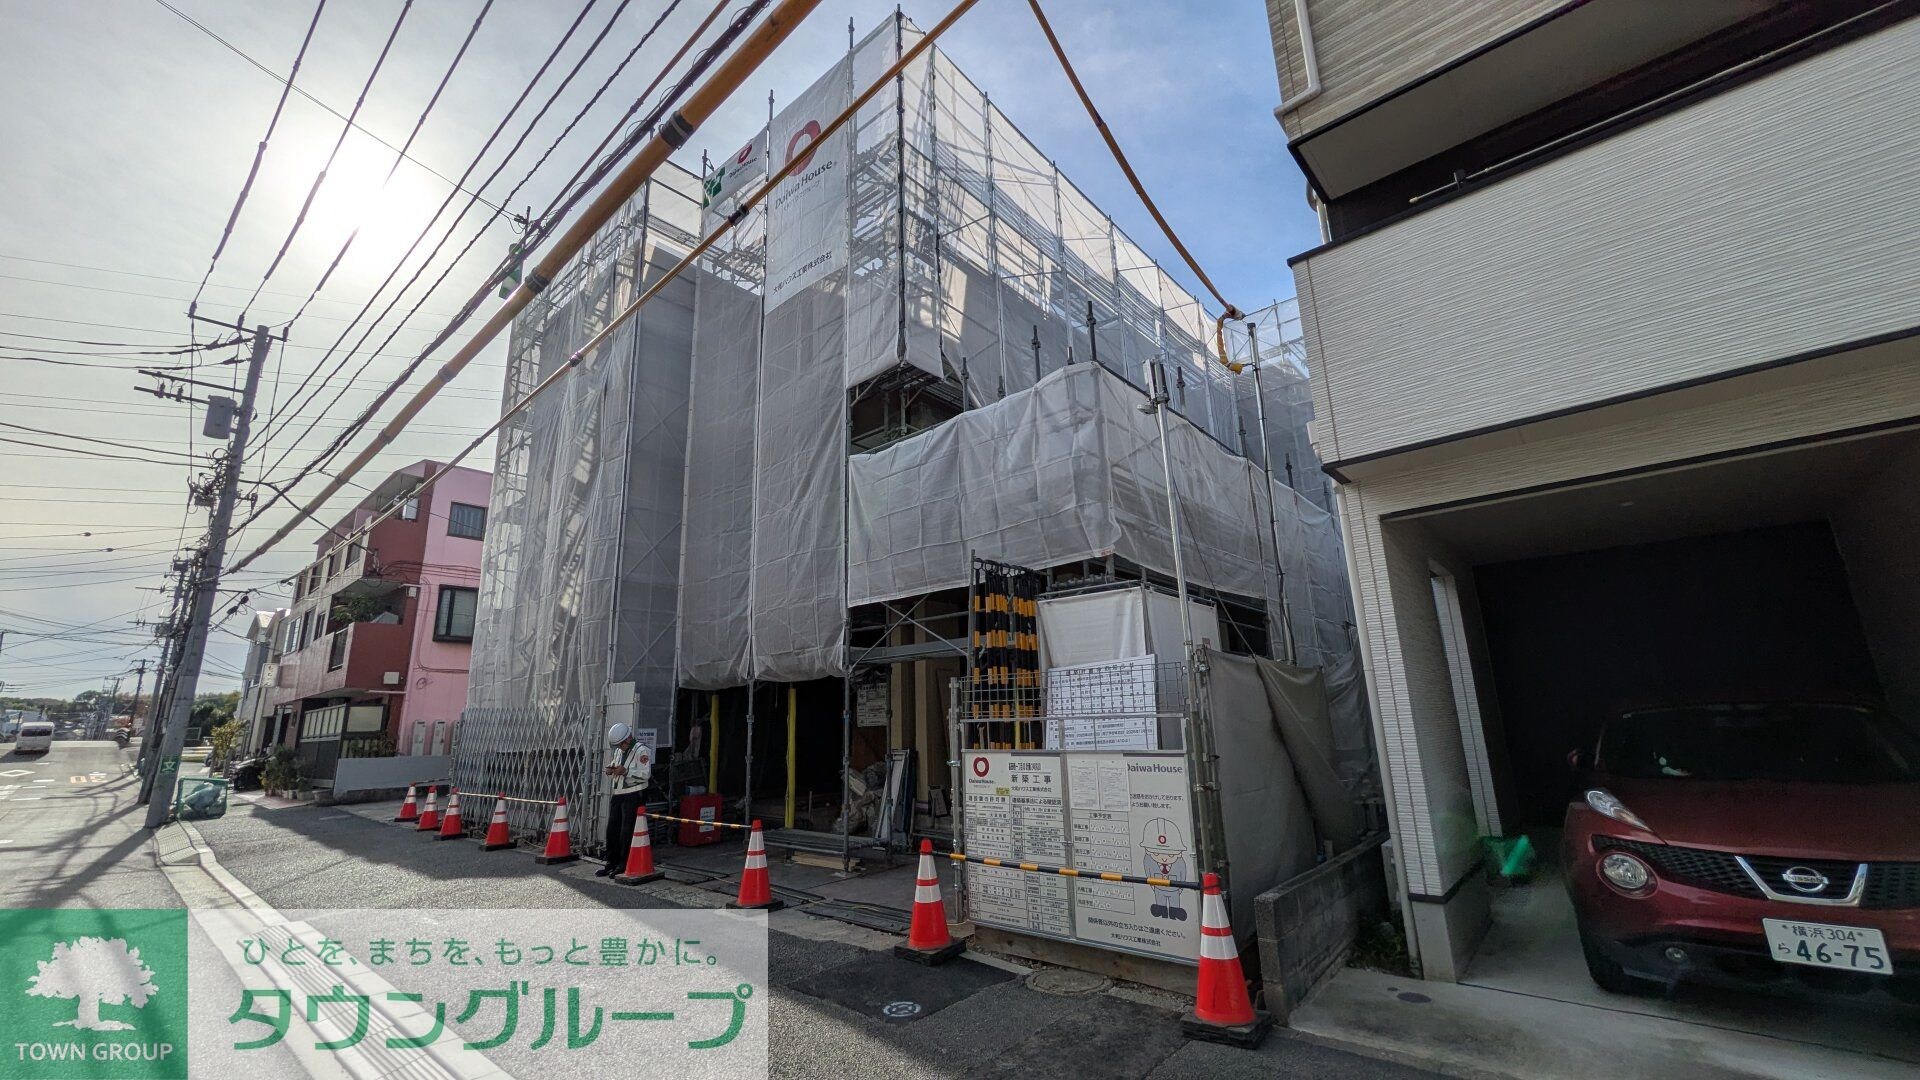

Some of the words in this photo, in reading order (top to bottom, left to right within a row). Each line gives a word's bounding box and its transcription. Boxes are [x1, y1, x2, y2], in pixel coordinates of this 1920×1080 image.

[1011, 774, 1052, 784] 新築工事
[1778, 942, 1791, 955] ら
[1796, 940, 1885, 970] 46-75
